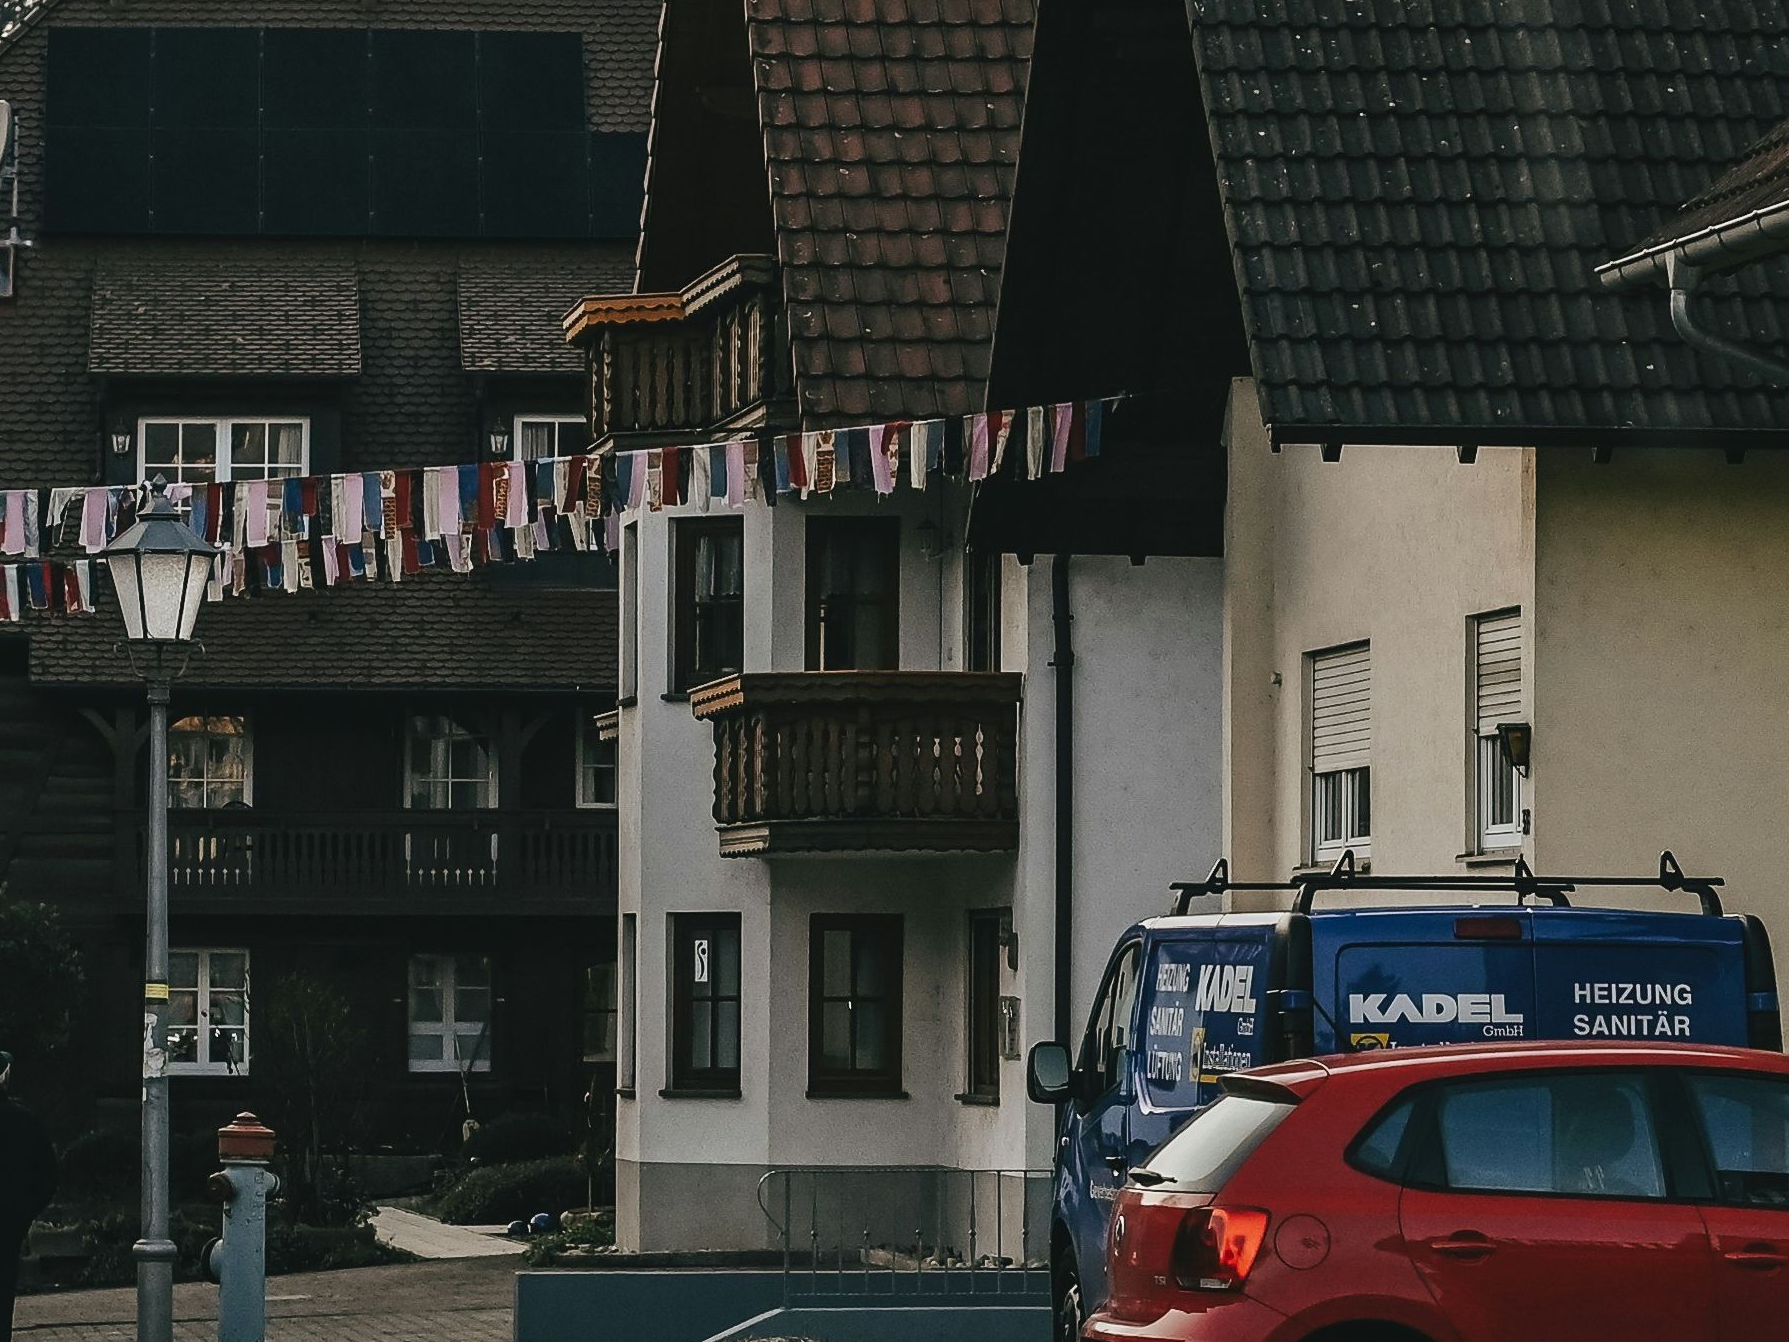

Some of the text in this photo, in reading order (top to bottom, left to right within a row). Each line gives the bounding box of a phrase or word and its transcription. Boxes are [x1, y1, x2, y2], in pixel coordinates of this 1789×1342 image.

[1156, 963, 1191, 993] HEIZUNG
[1195, 964, 1257, 1014] KADEL
[1574, 982, 1693, 1005] HEIZUNG
[1149, 1000, 1184, 1037] SANITÄR
[1349, 994, 1524, 1023] KADEL
[1483, 1025, 1524, 1037] GmbH
[1573, 1010, 1691, 1037] SANITÄR
[1147, 1043, 1183, 1082] LÜFTUNG
